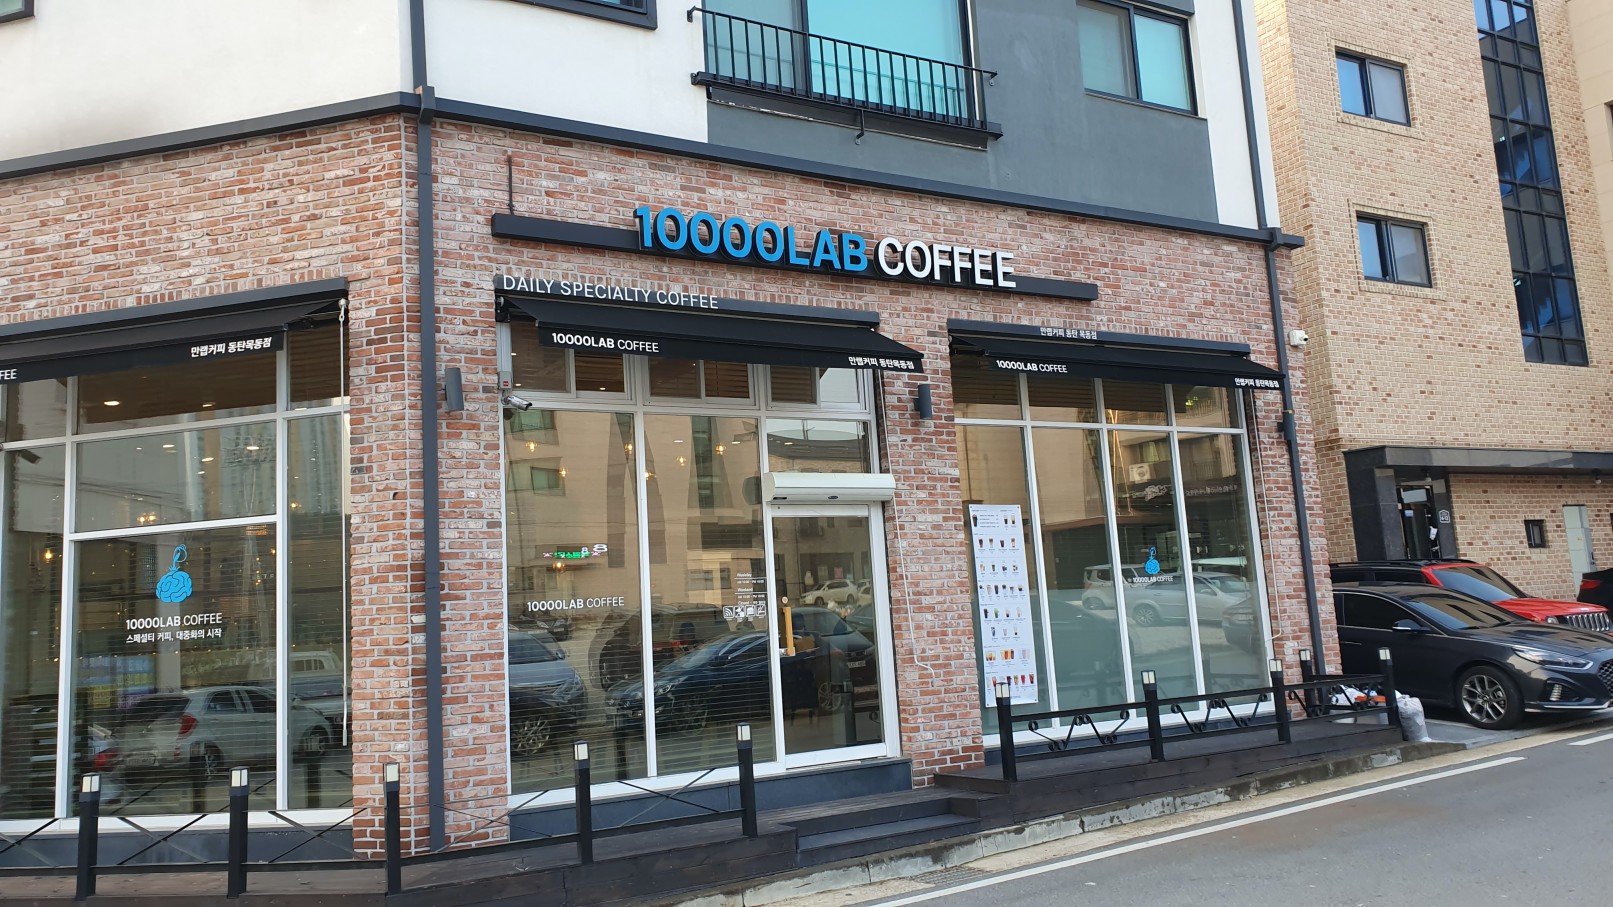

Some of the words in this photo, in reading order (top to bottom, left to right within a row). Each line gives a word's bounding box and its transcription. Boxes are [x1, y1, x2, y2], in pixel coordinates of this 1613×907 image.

[635, 205, 869, 272] 10000LAB
[876, 236, 1017, 288] COFFEE
[503, 275, 555, 294] DAILY
[560, 280, 651, 303] SPECIALTY
[656, 290, 719, 309] COFFEE
[190, 342, 226, 358] 만랩커피
[227, 336, 272, 353] 동탄목동점
[552, 332, 615, 349] 10000LAB
[617, 339, 660, 353] COFFEE
[996, 360, 1038, 371] 10000LAB
[1039, 363, 1068, 373] COFFEE
[527, 598, 584, 612] 10000LAB
[586, 596, 625, 608] COFFEE
[125, 615, 181, 630] 10000LAB
[183, 612, 223, 626] COFFEE
[125, 632, 155, 644] 스페셜티
[157, 631, 174, 642] 커피,
[175, 628, 205, 640] 대중화의
[206, 627, 222, 638] 시작
